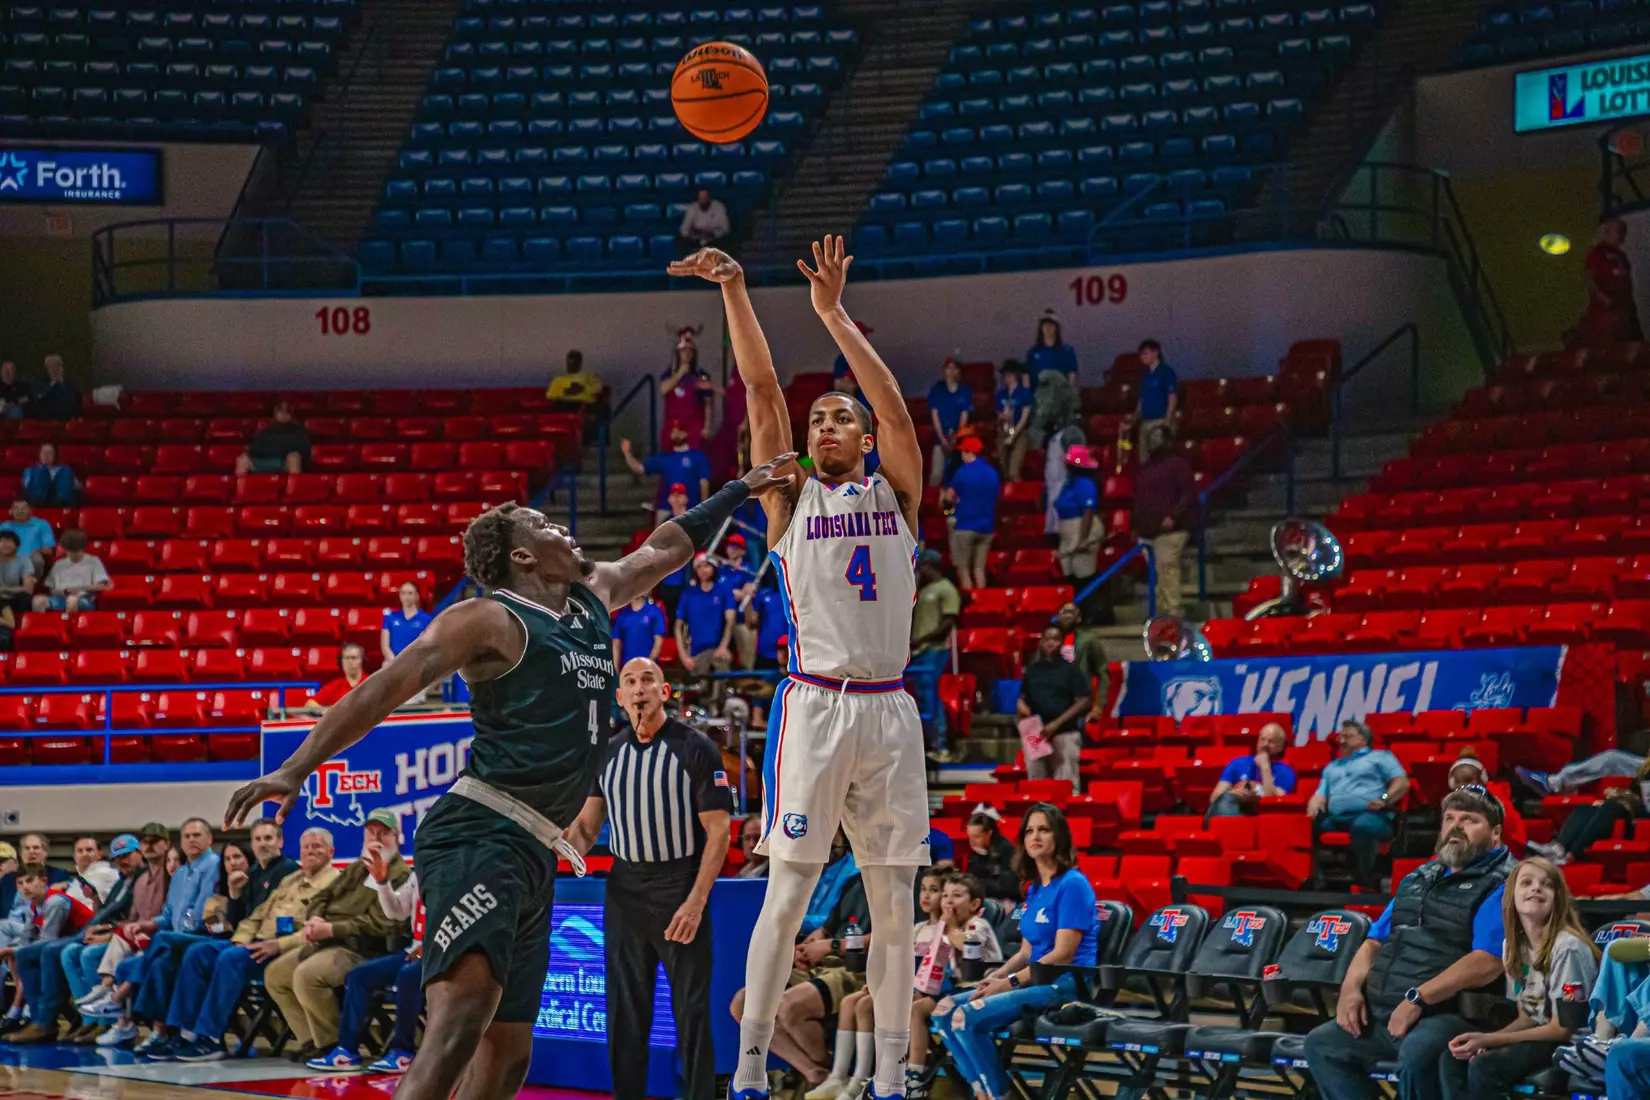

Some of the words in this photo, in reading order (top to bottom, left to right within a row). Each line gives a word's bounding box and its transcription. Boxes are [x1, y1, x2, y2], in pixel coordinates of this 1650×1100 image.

[64, 189, 121, 198] INSURANCE
[1069, 273, 1128, 306] 109
[315, 306, 371, 335] 108
[806, 511, 872, 540] LOUISIANA
[872, 510, 899, 537] TECH
[844, 545, 877, 602] 4
[577, 669, 606, 690] State
[588, 700, 598, 745] 4
[314, 760, 381, 807] TECH
[433, 883, 498, 952] BEARS
